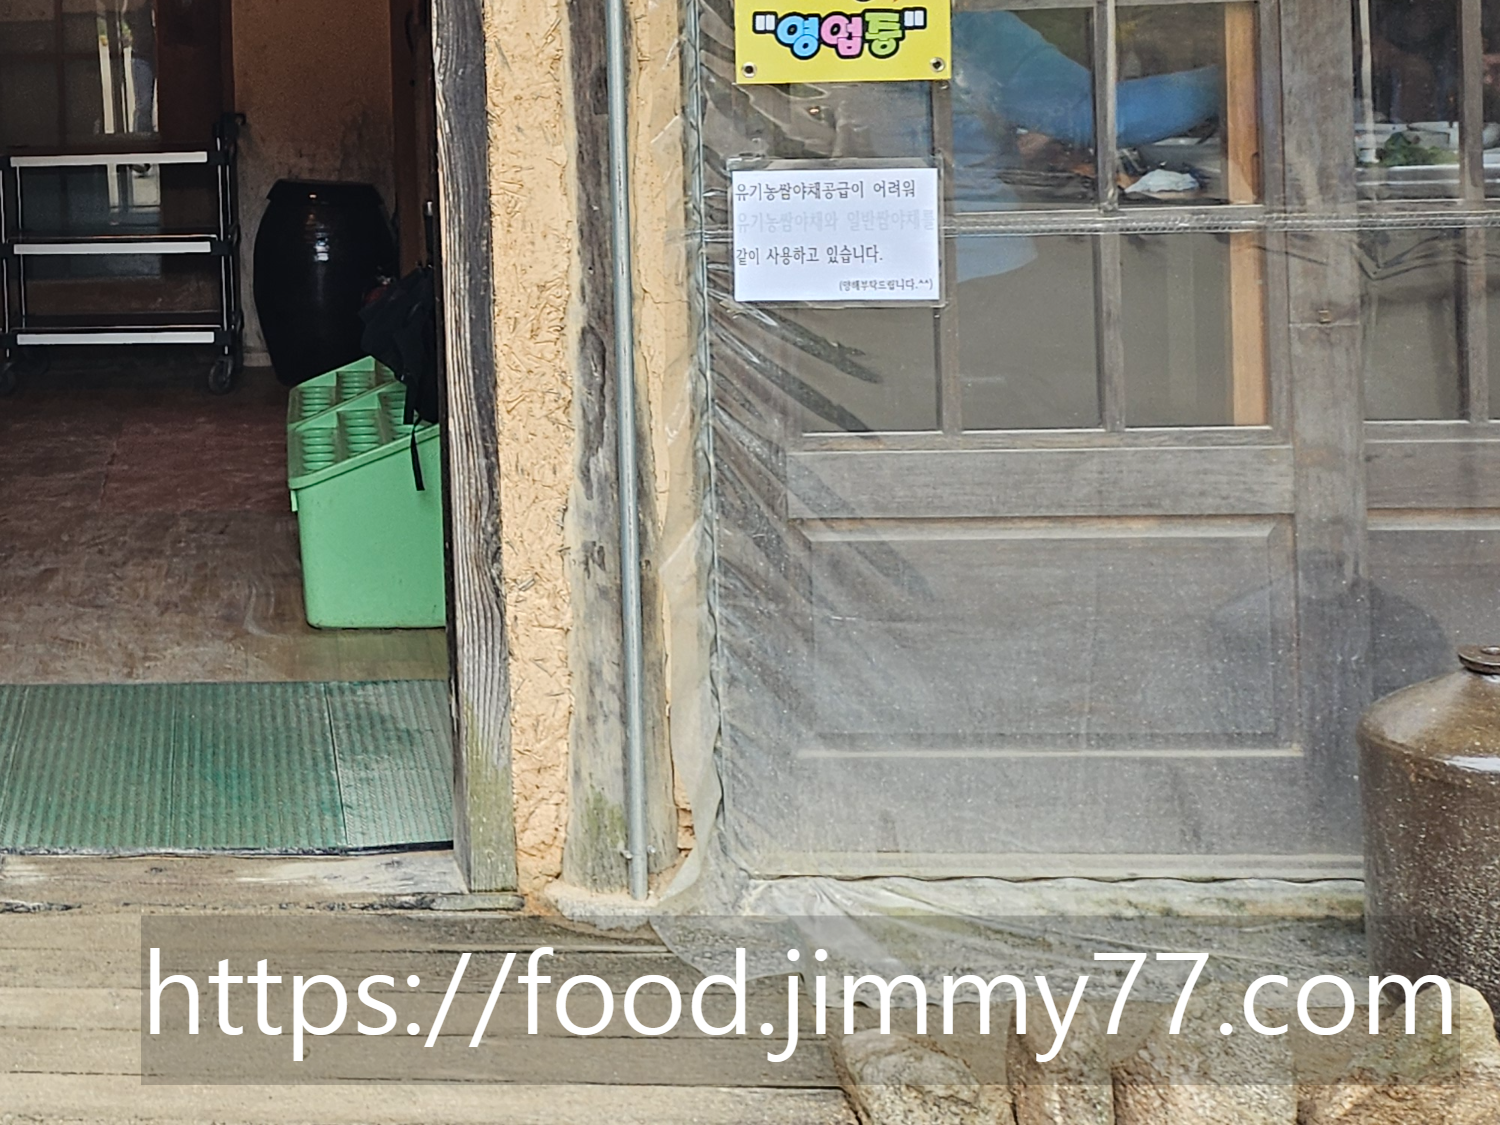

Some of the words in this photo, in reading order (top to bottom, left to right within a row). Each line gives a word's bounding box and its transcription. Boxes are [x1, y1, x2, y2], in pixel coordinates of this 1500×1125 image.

[734, 180, 865, 202] 유기농쌈야채공급이
[873, 179, 917, 198] 어려워
[735, 247, 760, 266] 같이
[766, 245, 820, 266] 사용하고
[826, 244, 884, 265] 있습니다.
